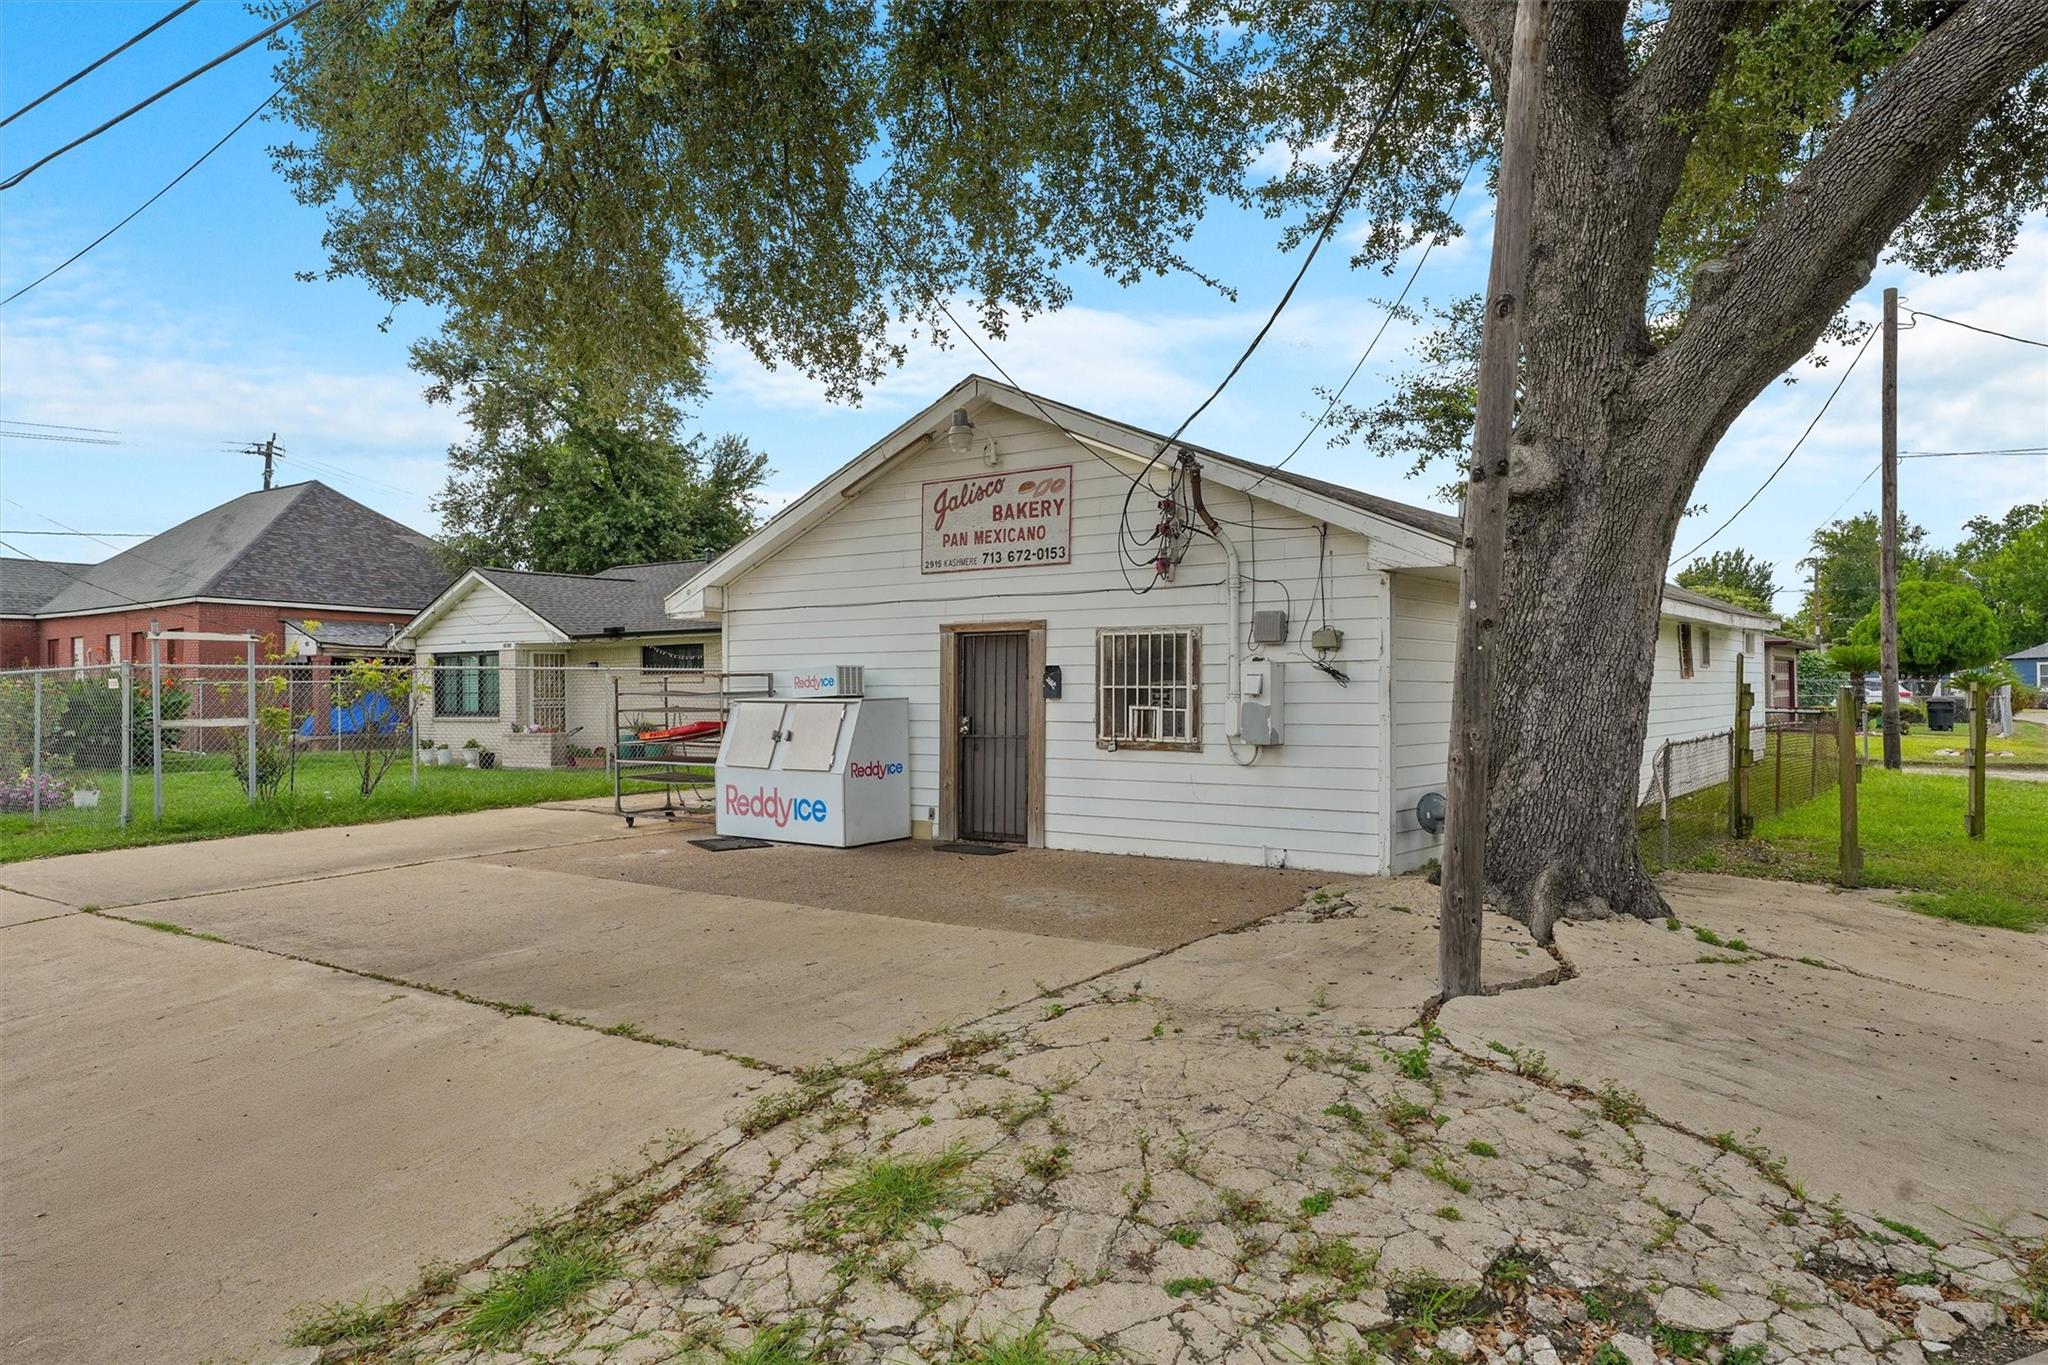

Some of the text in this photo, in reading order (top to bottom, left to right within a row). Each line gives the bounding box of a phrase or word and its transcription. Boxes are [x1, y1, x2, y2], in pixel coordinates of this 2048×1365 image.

[933, 478, 1006, 531] Jalisco
[992, 498, 1065, 521] BAKERY
[942, 525, 1046, 547] PAN MEXICANO
[925, 546, 1066, 569] 2915 KASHMERE 713 672-0153
